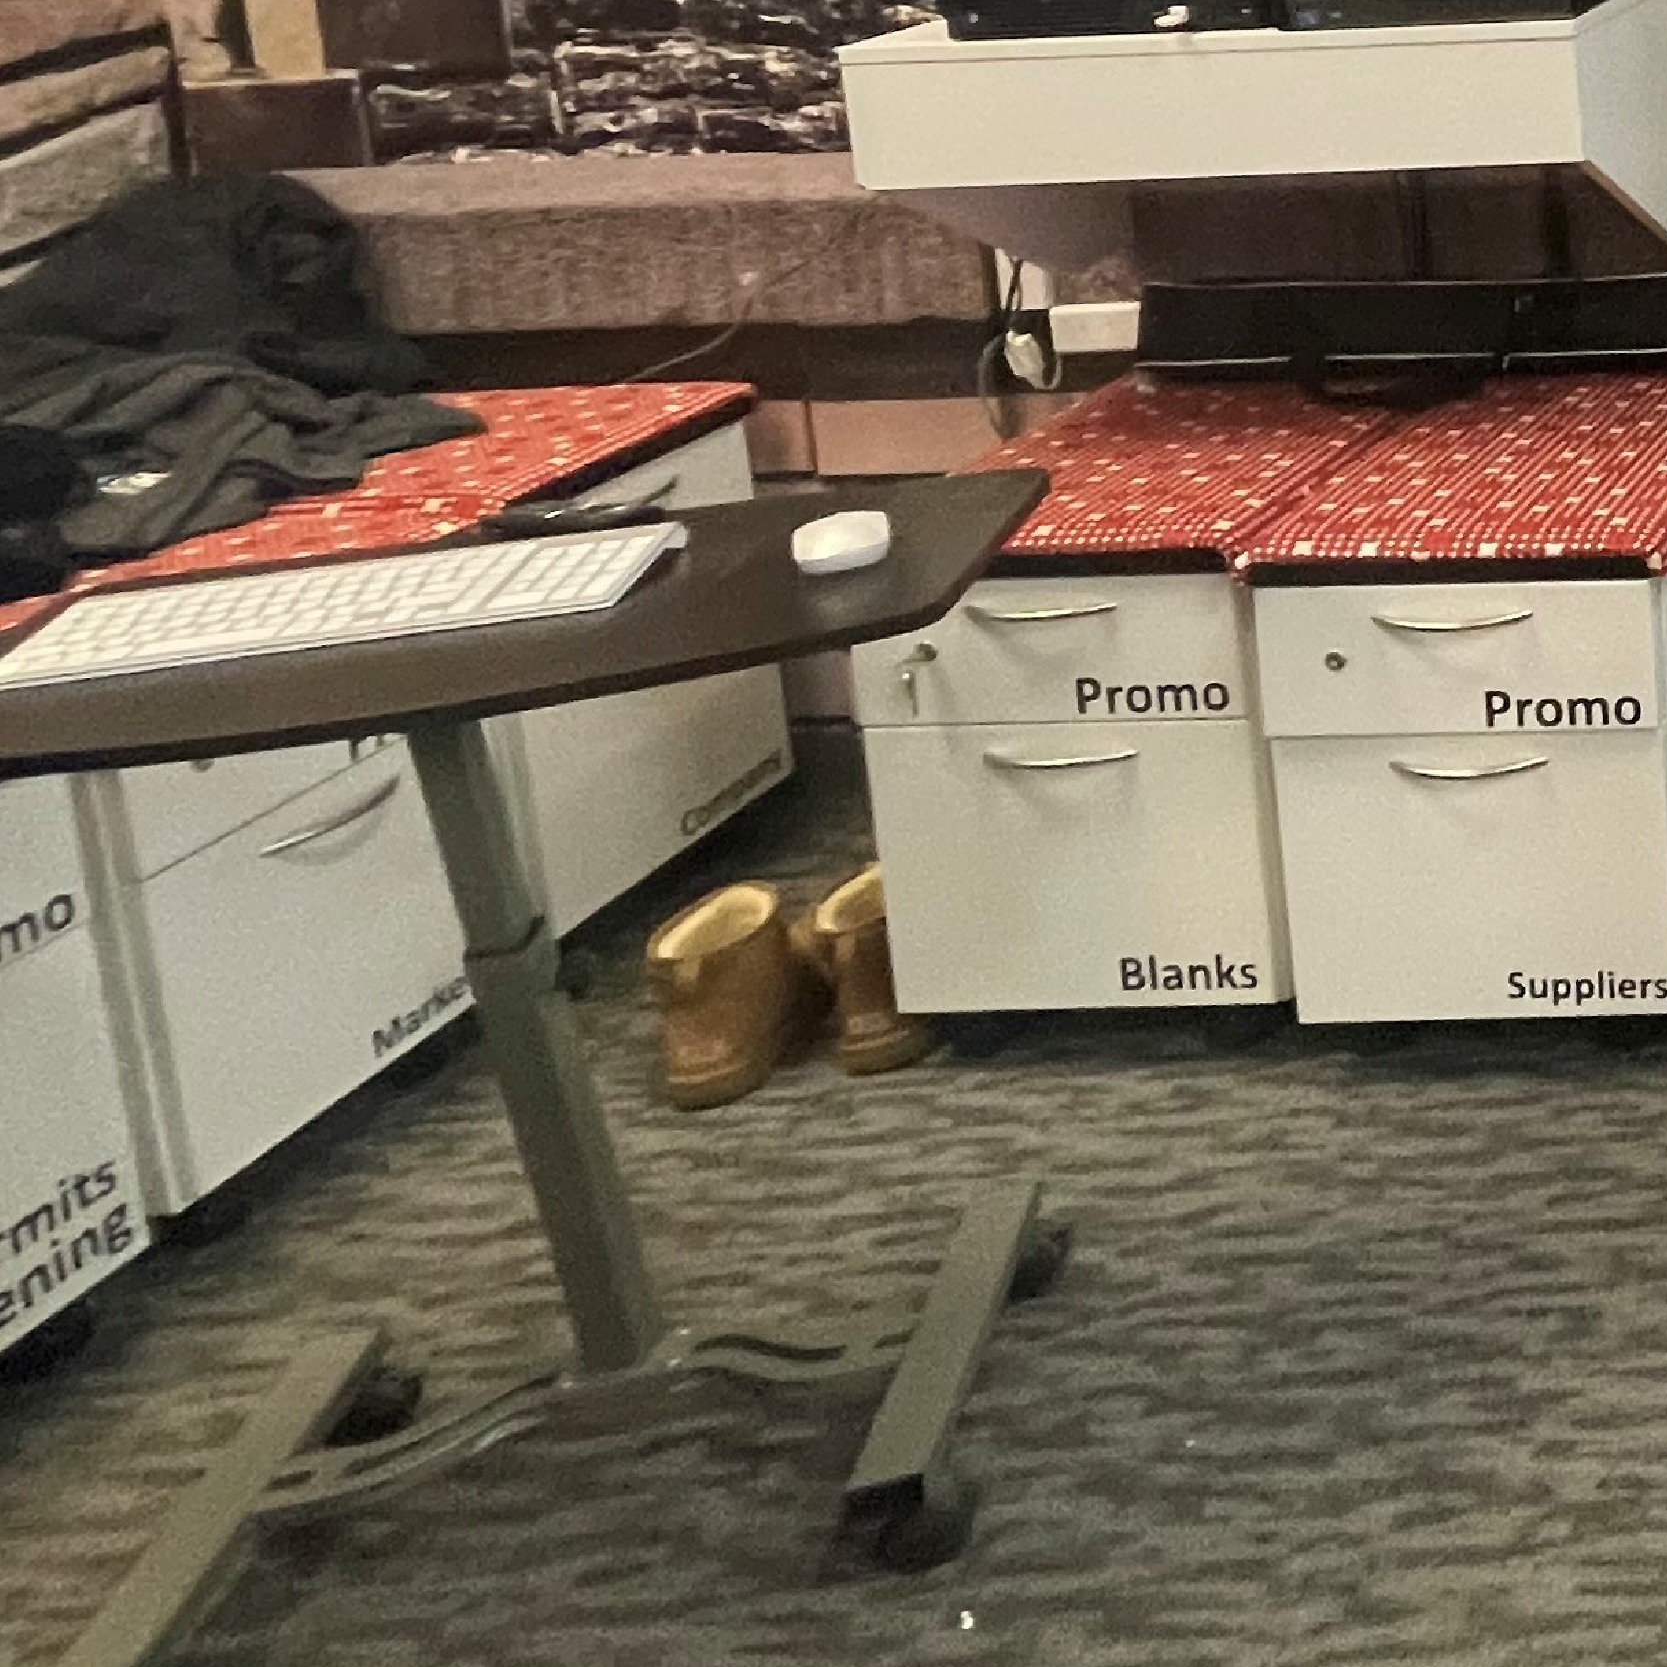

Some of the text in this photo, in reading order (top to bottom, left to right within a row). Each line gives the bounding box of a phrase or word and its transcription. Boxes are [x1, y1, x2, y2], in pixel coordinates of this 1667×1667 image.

[1076, 677, 1229, 714] Promo
[1485, 691, 1641, 727] Promo
[1120, 954, 1257, 991] Blanks
[1508, 971, 1667, 1006] Suppliers
[0, 1159, 117, 1254] mits
